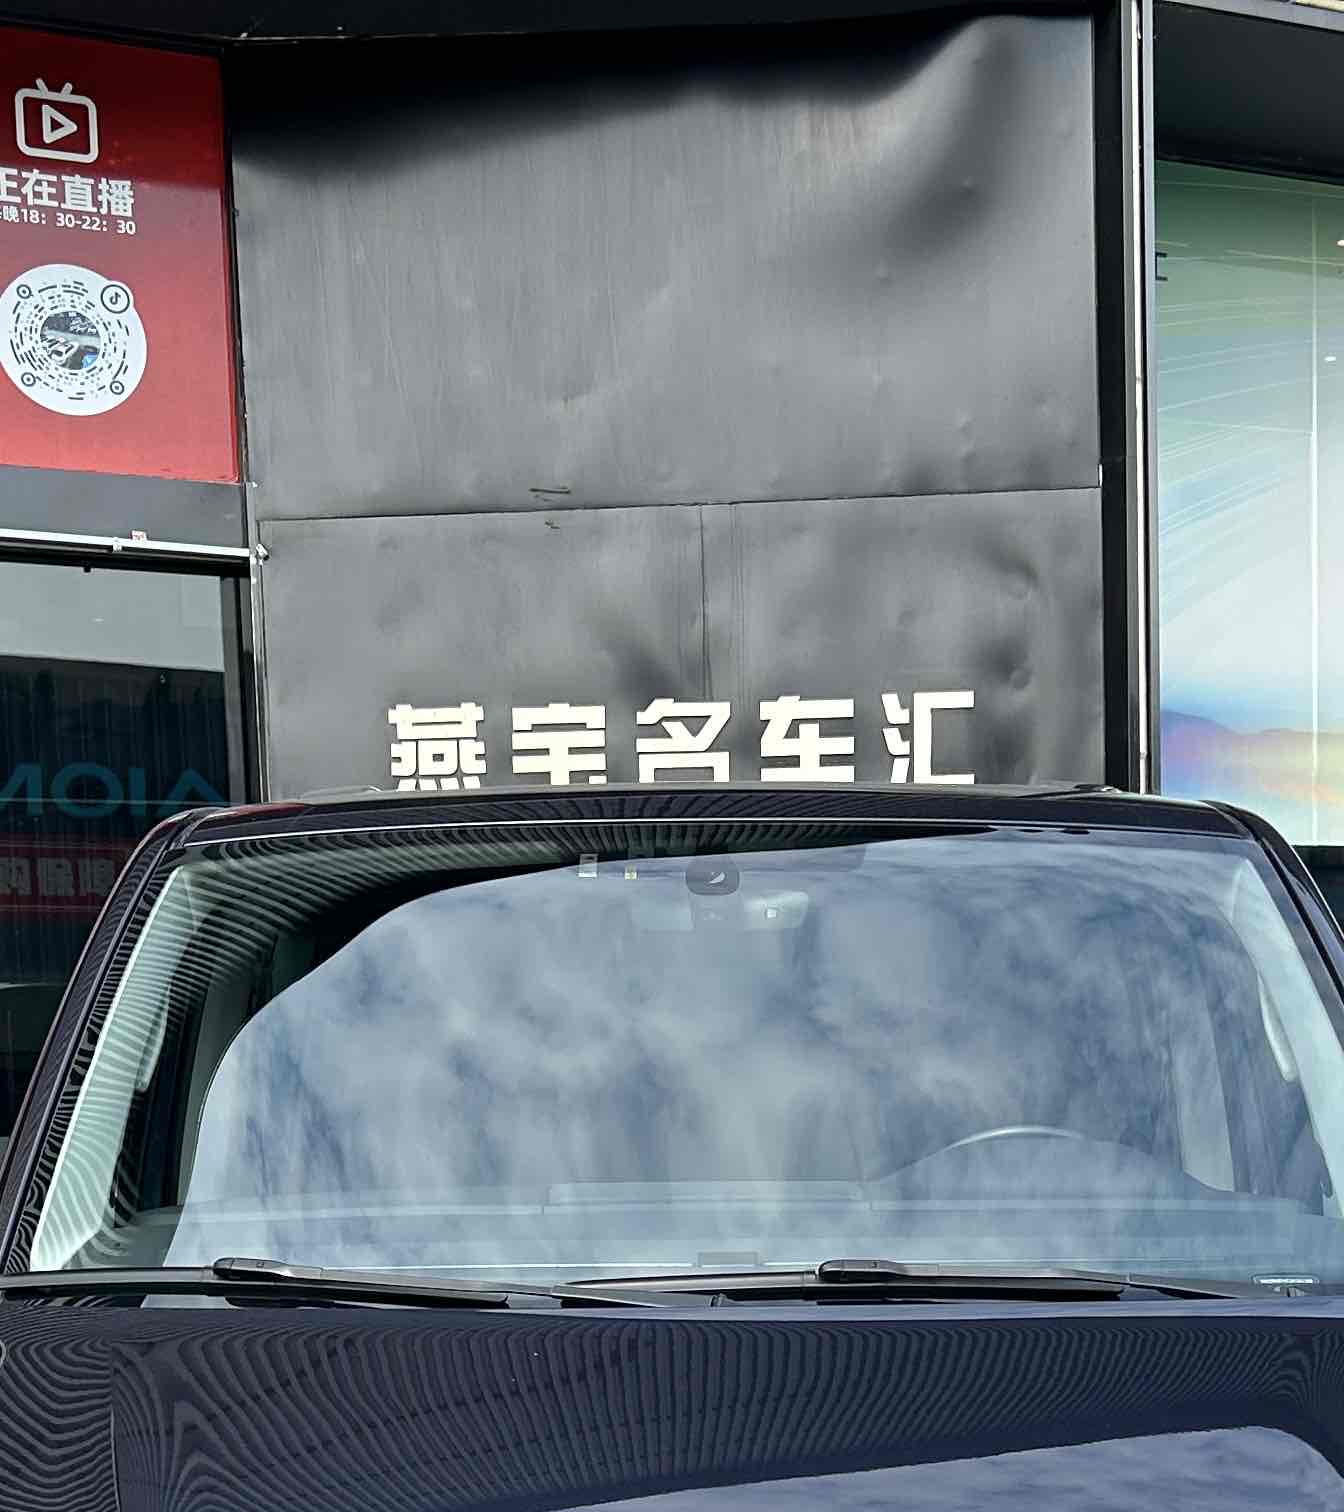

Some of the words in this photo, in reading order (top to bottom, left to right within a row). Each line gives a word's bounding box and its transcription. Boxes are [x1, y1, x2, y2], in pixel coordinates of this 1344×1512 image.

[388, 690, 975, 791] 燕宝名车汇
